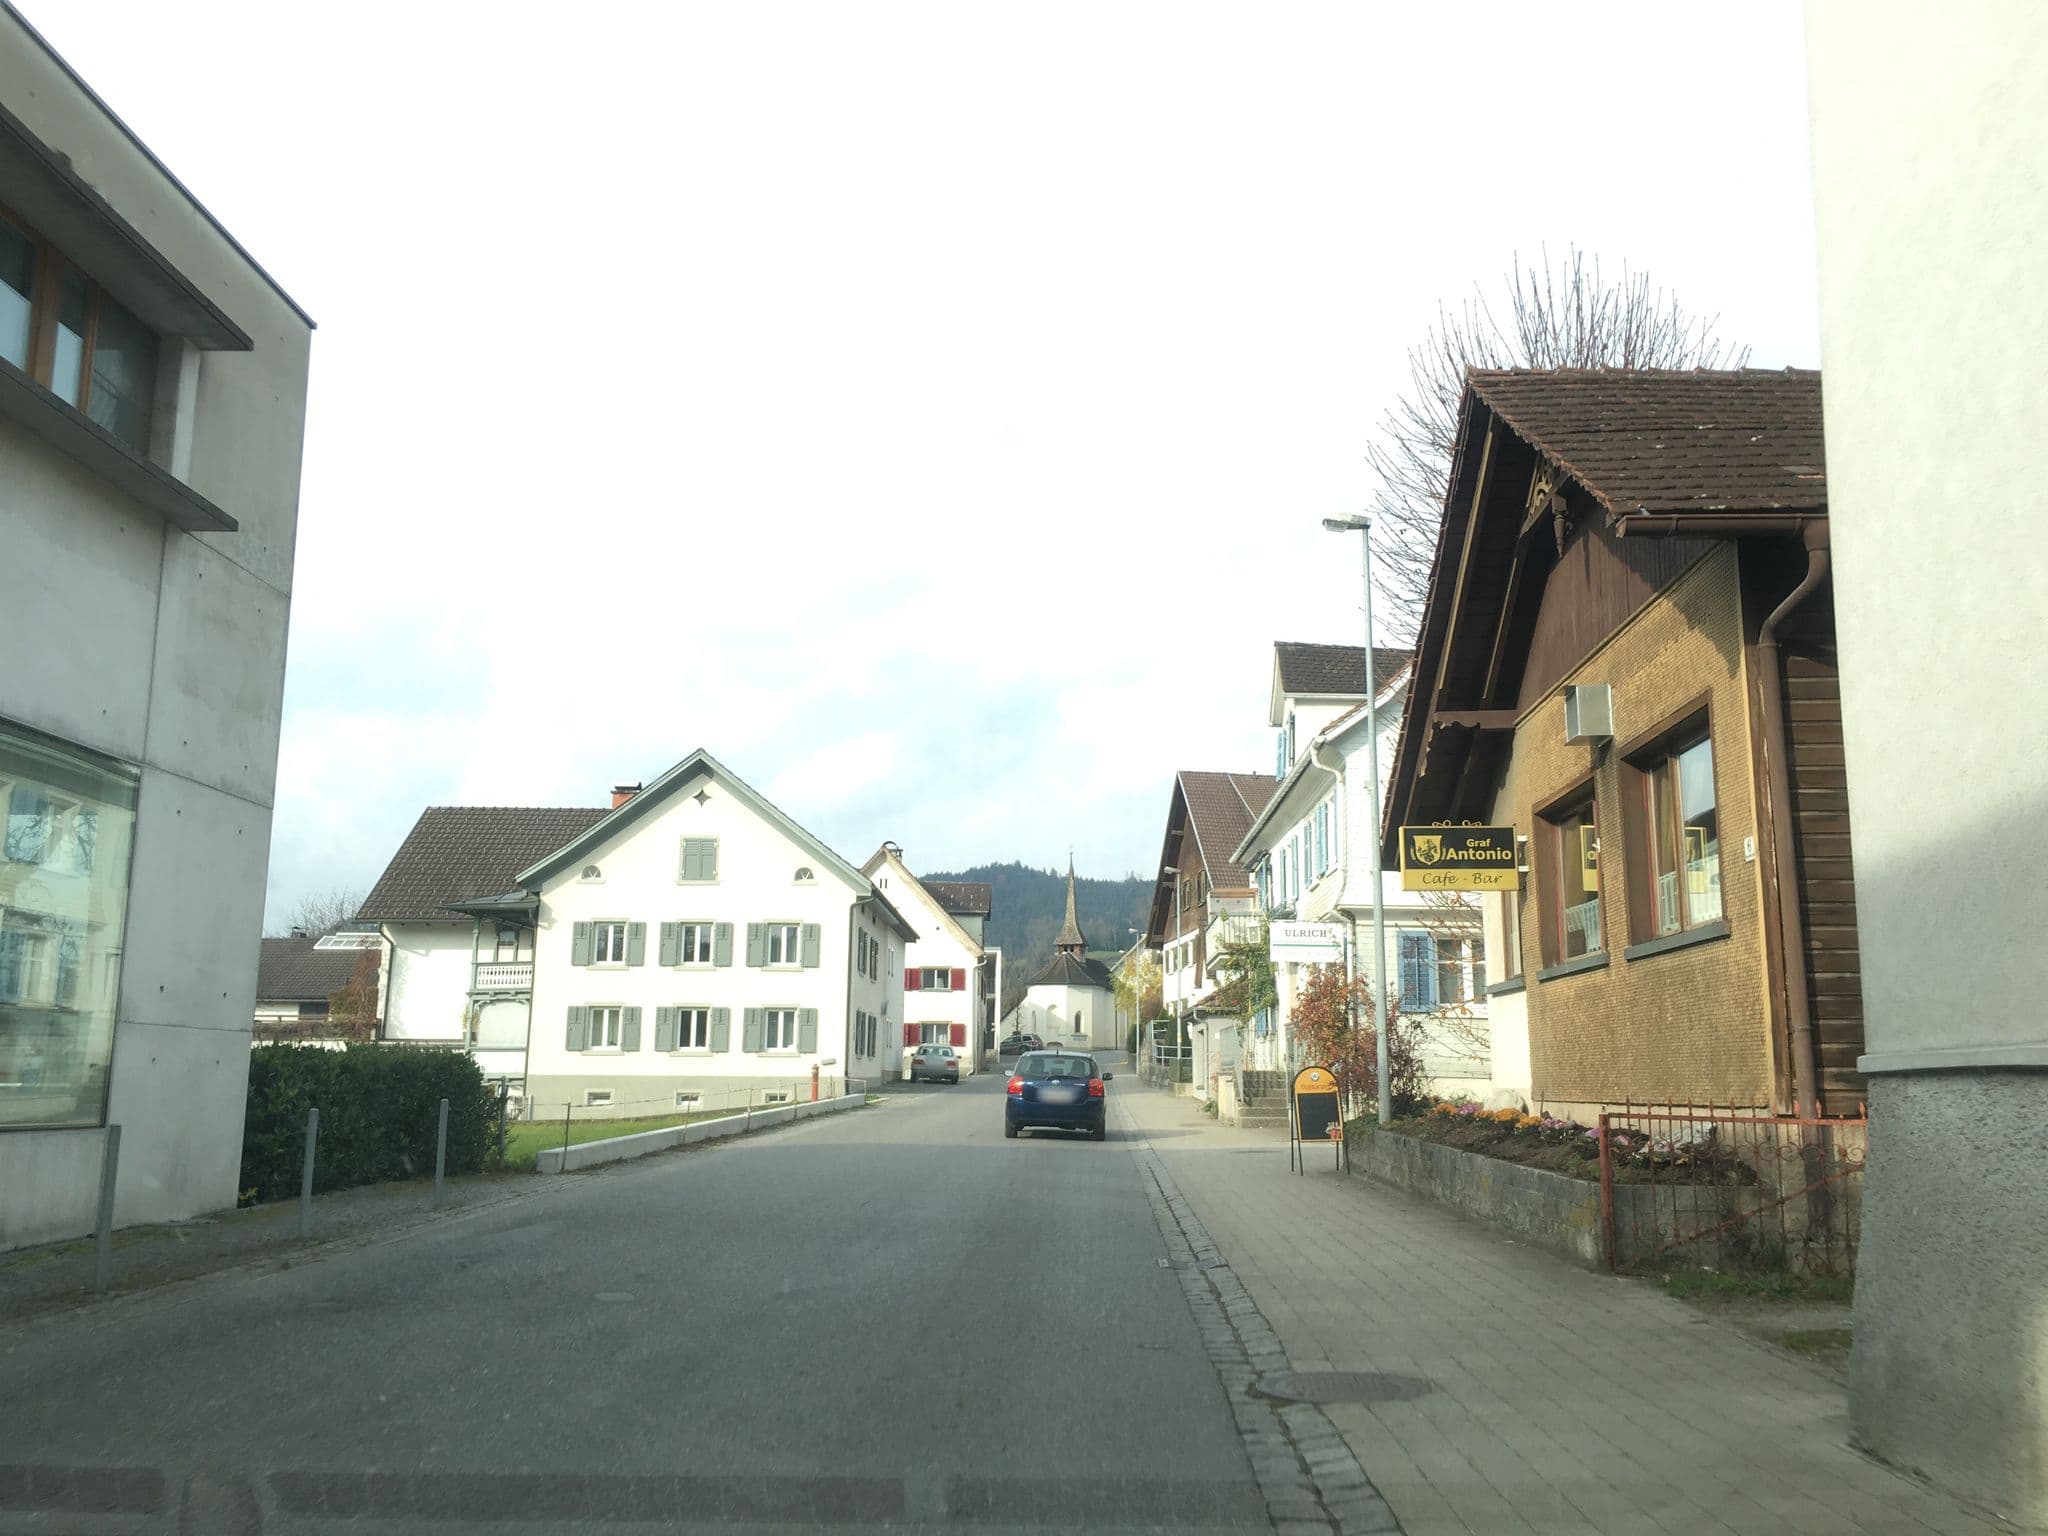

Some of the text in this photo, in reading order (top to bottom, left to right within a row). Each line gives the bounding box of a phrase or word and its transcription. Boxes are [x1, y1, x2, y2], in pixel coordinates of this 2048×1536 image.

[1466, 838, 1491, 847] Graf
[1747, 838, 1752, 853] 6
[1446, 847, 1512, 861] Antonio
[1423, 872, 1458, 886] Cafe
[1472, 872, 1503, 884] Bar
[1285, 929, 1327, 937] ULRICH
